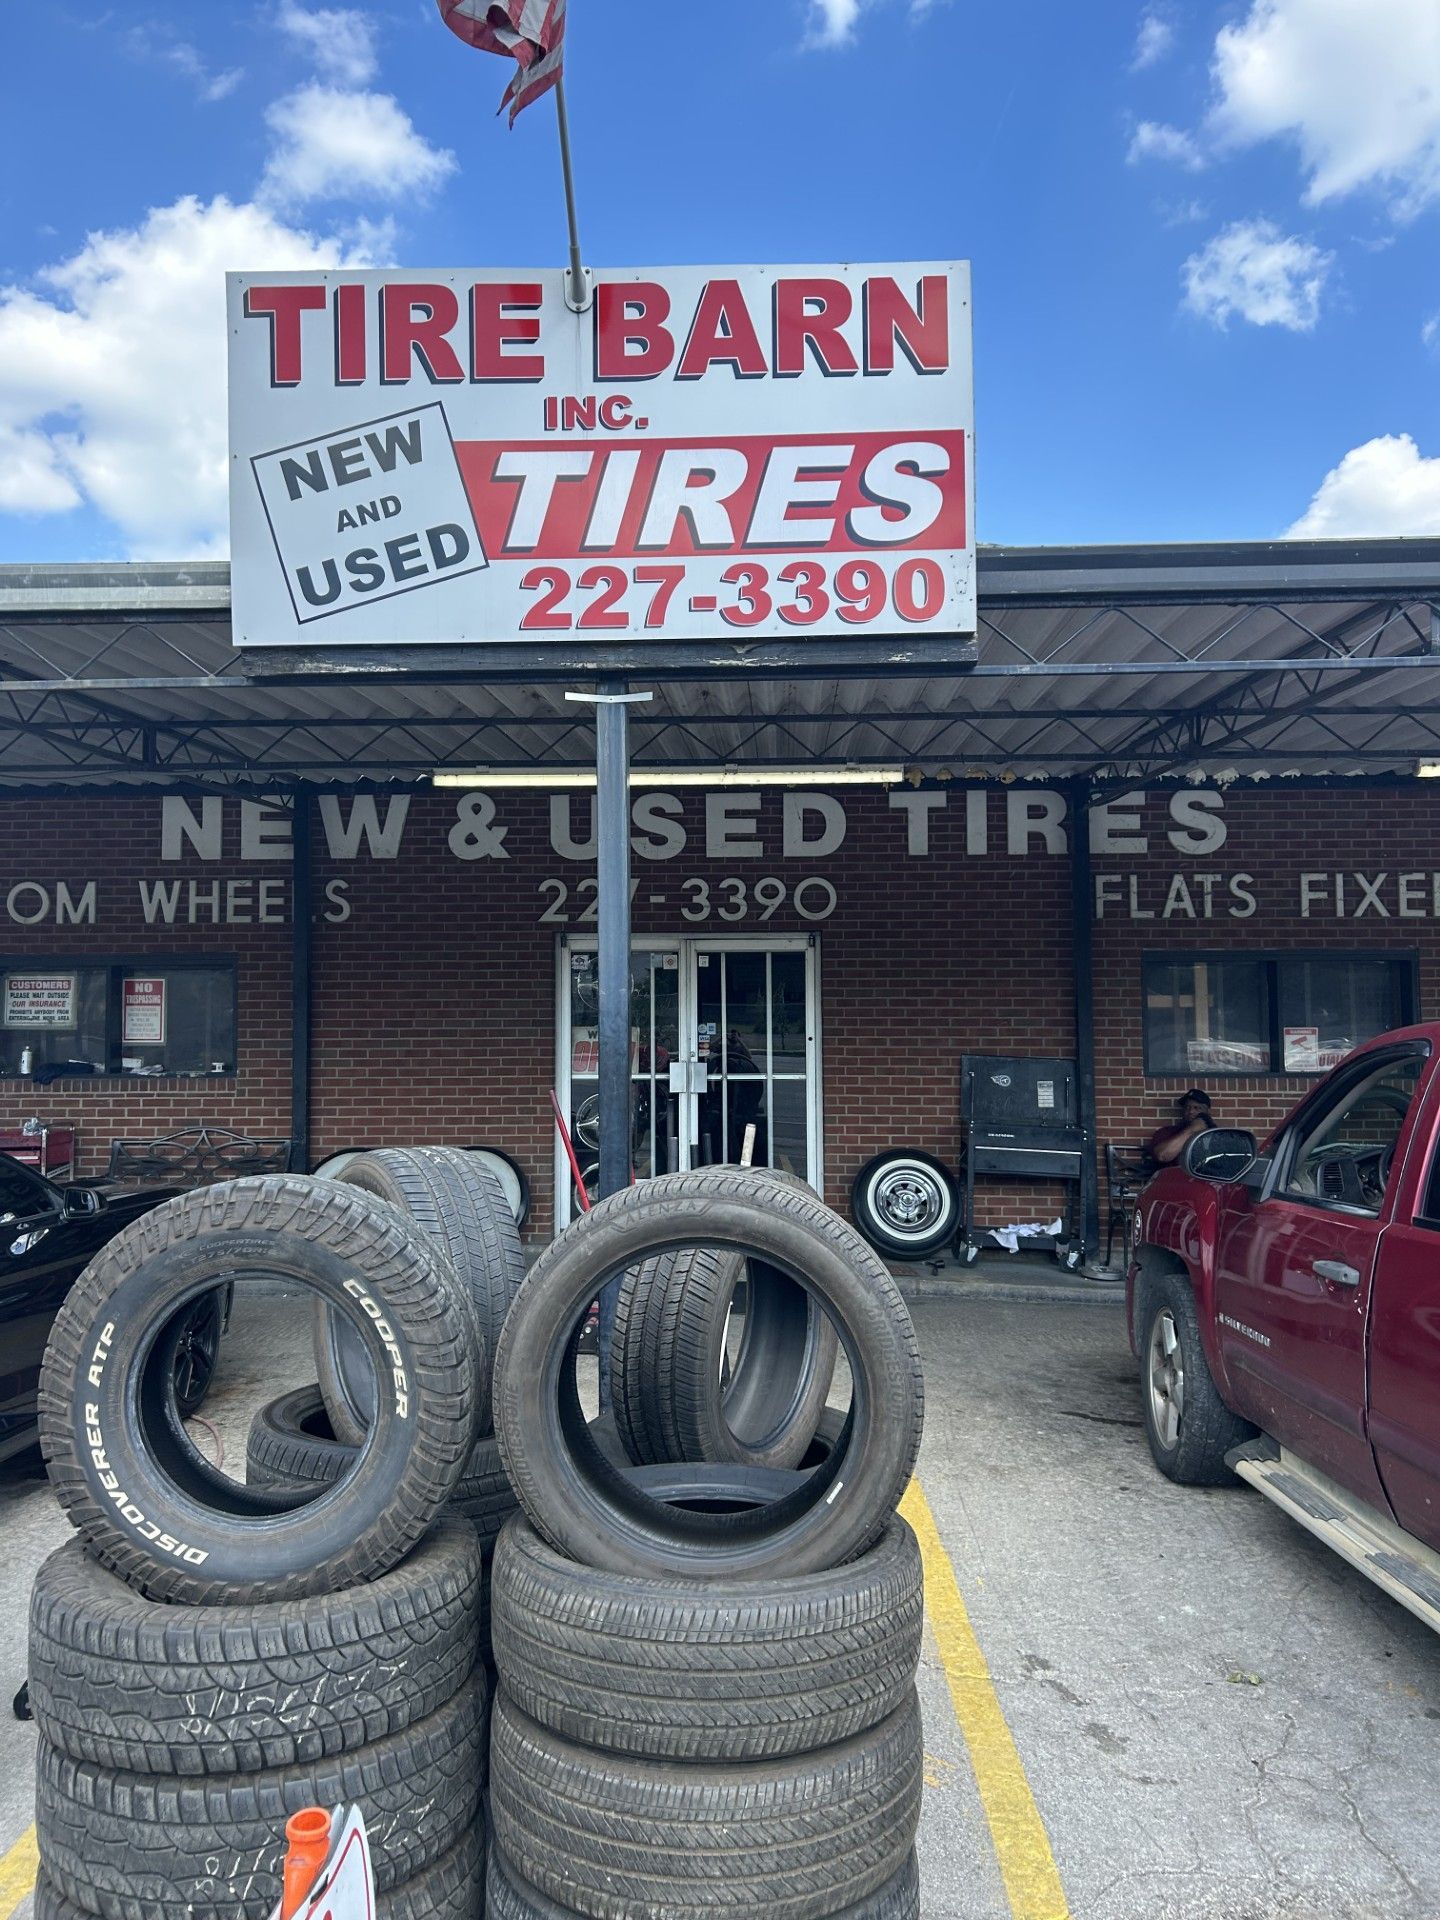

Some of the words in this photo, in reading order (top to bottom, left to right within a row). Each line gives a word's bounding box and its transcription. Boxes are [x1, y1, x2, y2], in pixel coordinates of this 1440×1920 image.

[244, 284, 545, 388] TIRE
[593, 276, 949, 382] BARN
[544, 395, 649, 431] INC.
[280, 419, 423, 502] NEW
[336, 494, 402, 533] AND
[491, 442, 950, 552] TIRES
[295, 522, 471, 608] USED
[519, 558, 945, 630] 227-3390
[161, 794, 410, 861] NEW
[448, 792, 511, 861] &
[549, 792, 846, 861] USED
[889, 790, 1228, 857] TIRES
[138, 879, 351, 923] WHEES
[1094, 873, 1257, 919] FLATS
[11, 981, 69, 989] CUSTOMERS
[12, 1000, 26, 1008] OUR
[28, 1000, 67, 1008] INSURANCE
[135, 982, 153, 993] NO
[87, 1321, 116, 1388] ATP
[342, 1278, 409, 1420] COOPER
[85, 1402, 210, 1566] DISCOVERER
